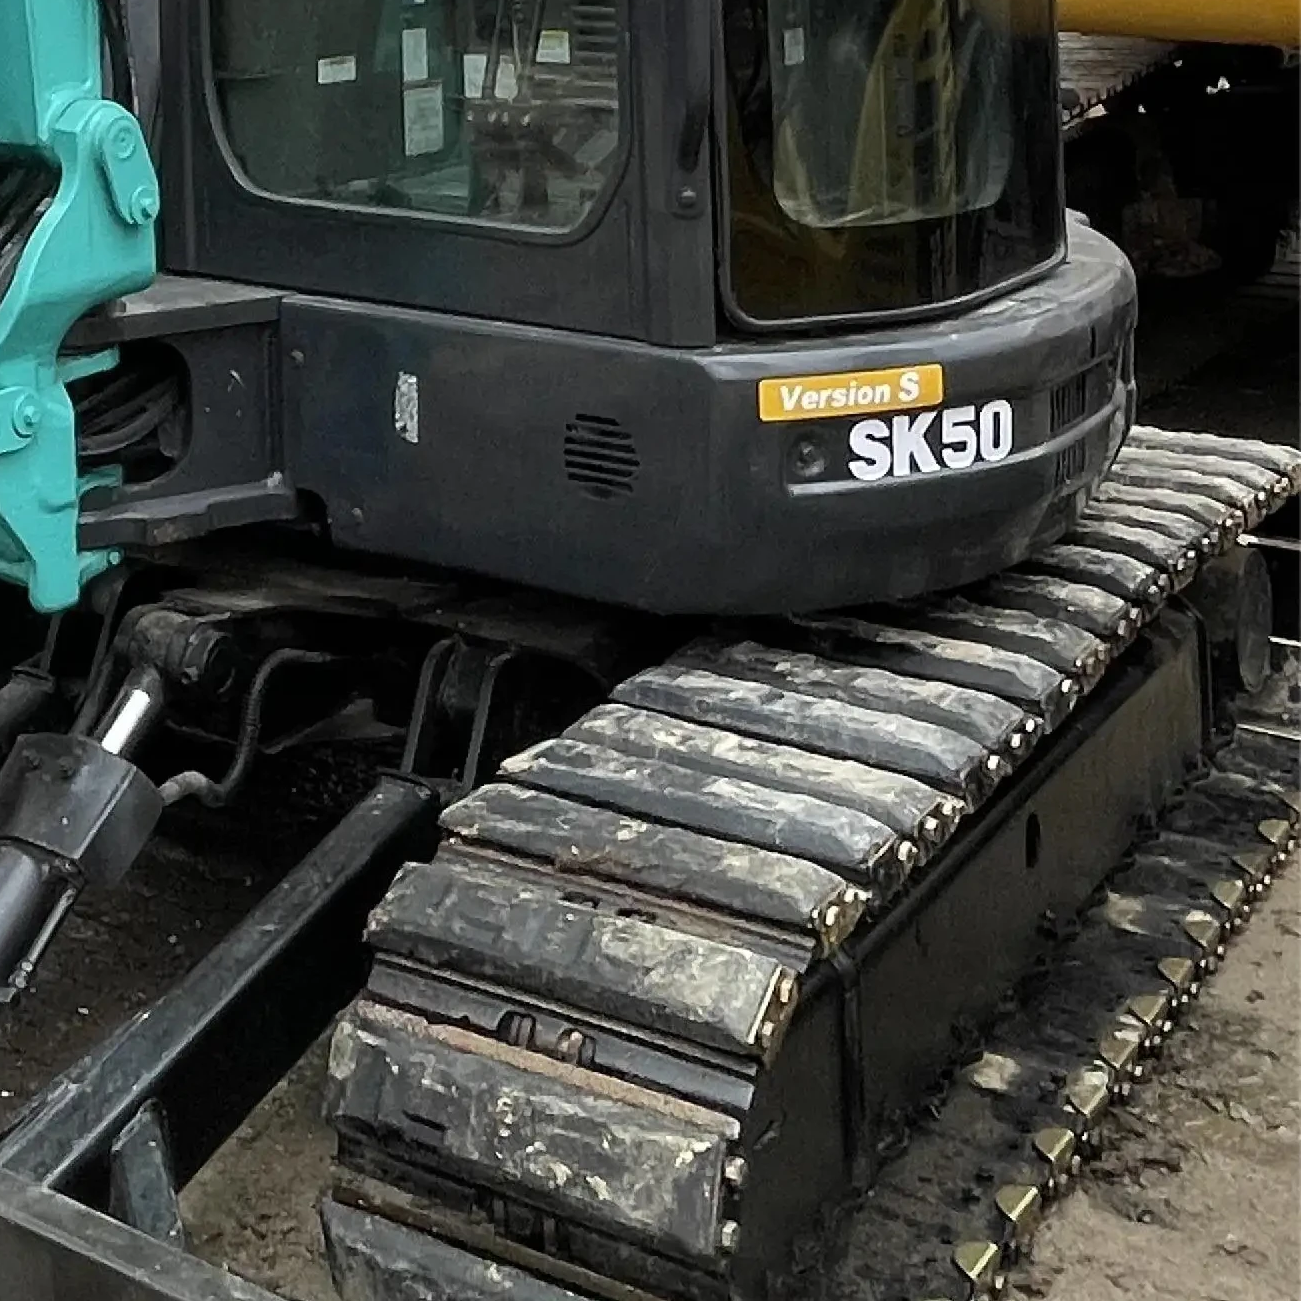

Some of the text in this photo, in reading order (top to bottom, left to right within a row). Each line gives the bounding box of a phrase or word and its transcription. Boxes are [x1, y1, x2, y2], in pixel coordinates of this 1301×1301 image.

[780, 371, 920, 411] Version S
[848, 399, 1013, 481] SK50
